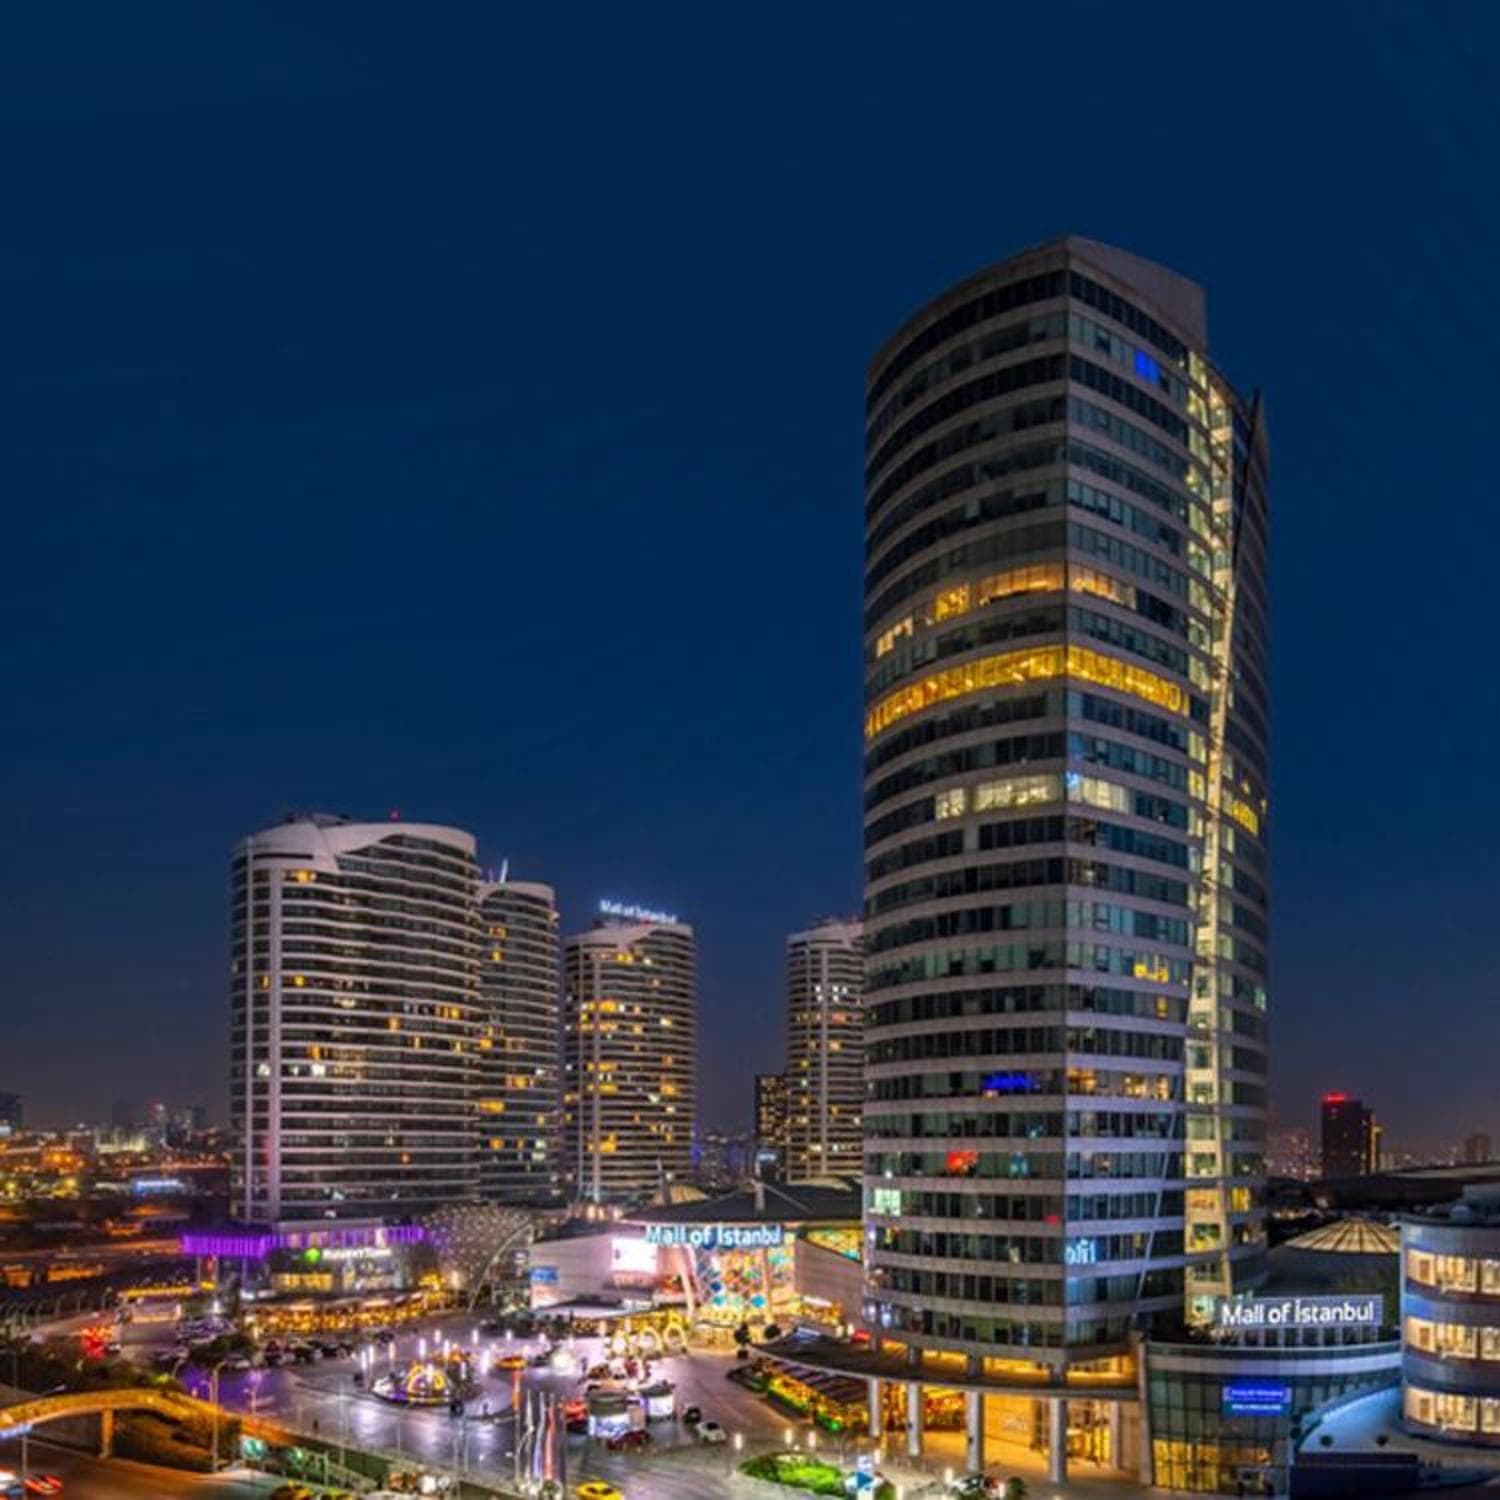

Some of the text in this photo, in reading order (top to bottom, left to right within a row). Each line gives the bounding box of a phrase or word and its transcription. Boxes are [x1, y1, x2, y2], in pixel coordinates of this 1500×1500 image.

[646, 1223, 686, 1244] Mall
[689, 1223, 712, 1243] of
[1221, 1303, 1264, 1325] Mall
[1267, 1302, 1292, 1324] of
